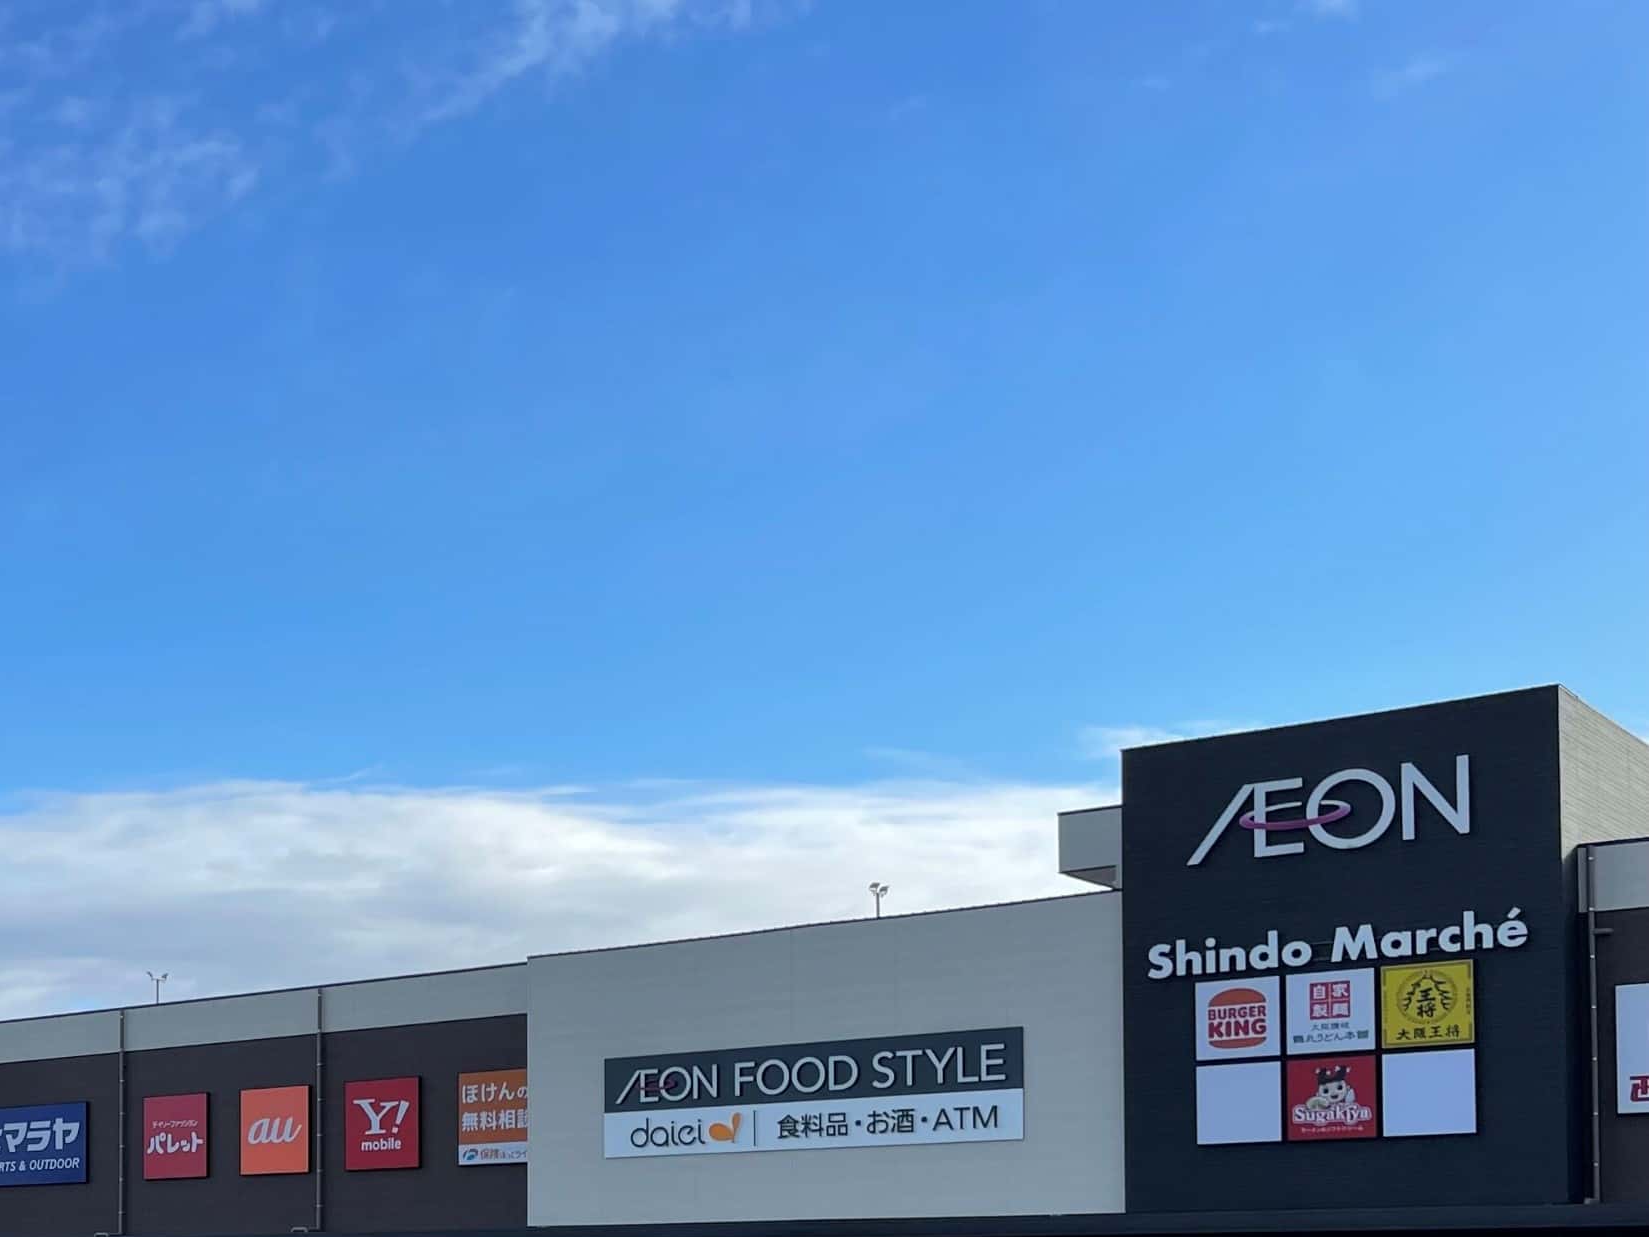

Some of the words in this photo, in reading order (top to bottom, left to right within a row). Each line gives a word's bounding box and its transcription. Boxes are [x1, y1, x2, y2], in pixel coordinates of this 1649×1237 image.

[1147, 929, 1312, 979] Shindo
[1331, 907, 1529, 963] Marché
[1208, 1005, 1266, 1021] BURGER
[1208, 1018, 1267, 1039] KING
[1396, 1024, 1461, 1041] 大阪王将
[734, 1055, 859, 1097] FOOD
[872, 1043, 1006, 1089] STYLE
[353, 1098, 409, 1135] Y!
[248, 1117, 302, 1144] au
[631, 1117, 706, 1148] daiei
[147, 1131, 203, 1154] パレット
[361, 1137, 402, 1151] mobile
[18, 1160, 26, 1172] &
[30, 1157, 80, 1170] OUTDOOR
